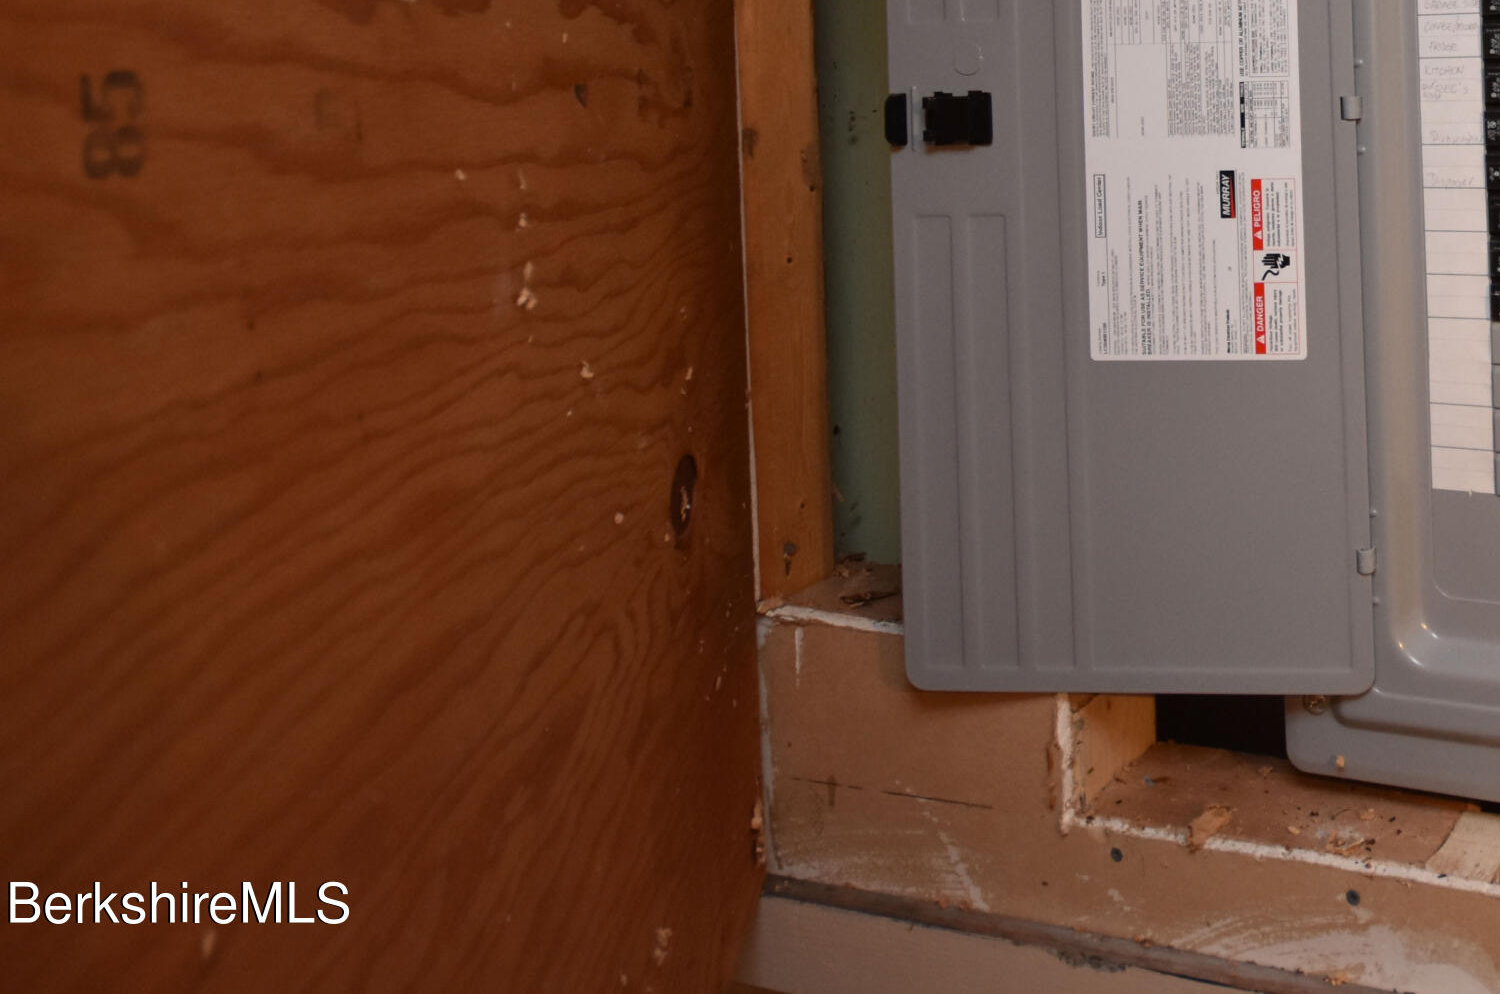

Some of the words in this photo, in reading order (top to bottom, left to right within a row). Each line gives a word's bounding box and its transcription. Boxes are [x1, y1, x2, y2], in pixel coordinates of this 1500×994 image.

[79, 70, 146, 180] 85
[1221, 174, 1231, 216] MURRAY
[1252, 189, 1262, 228] PELIGRO
[1255, 295, 1265, 333] DANGER
